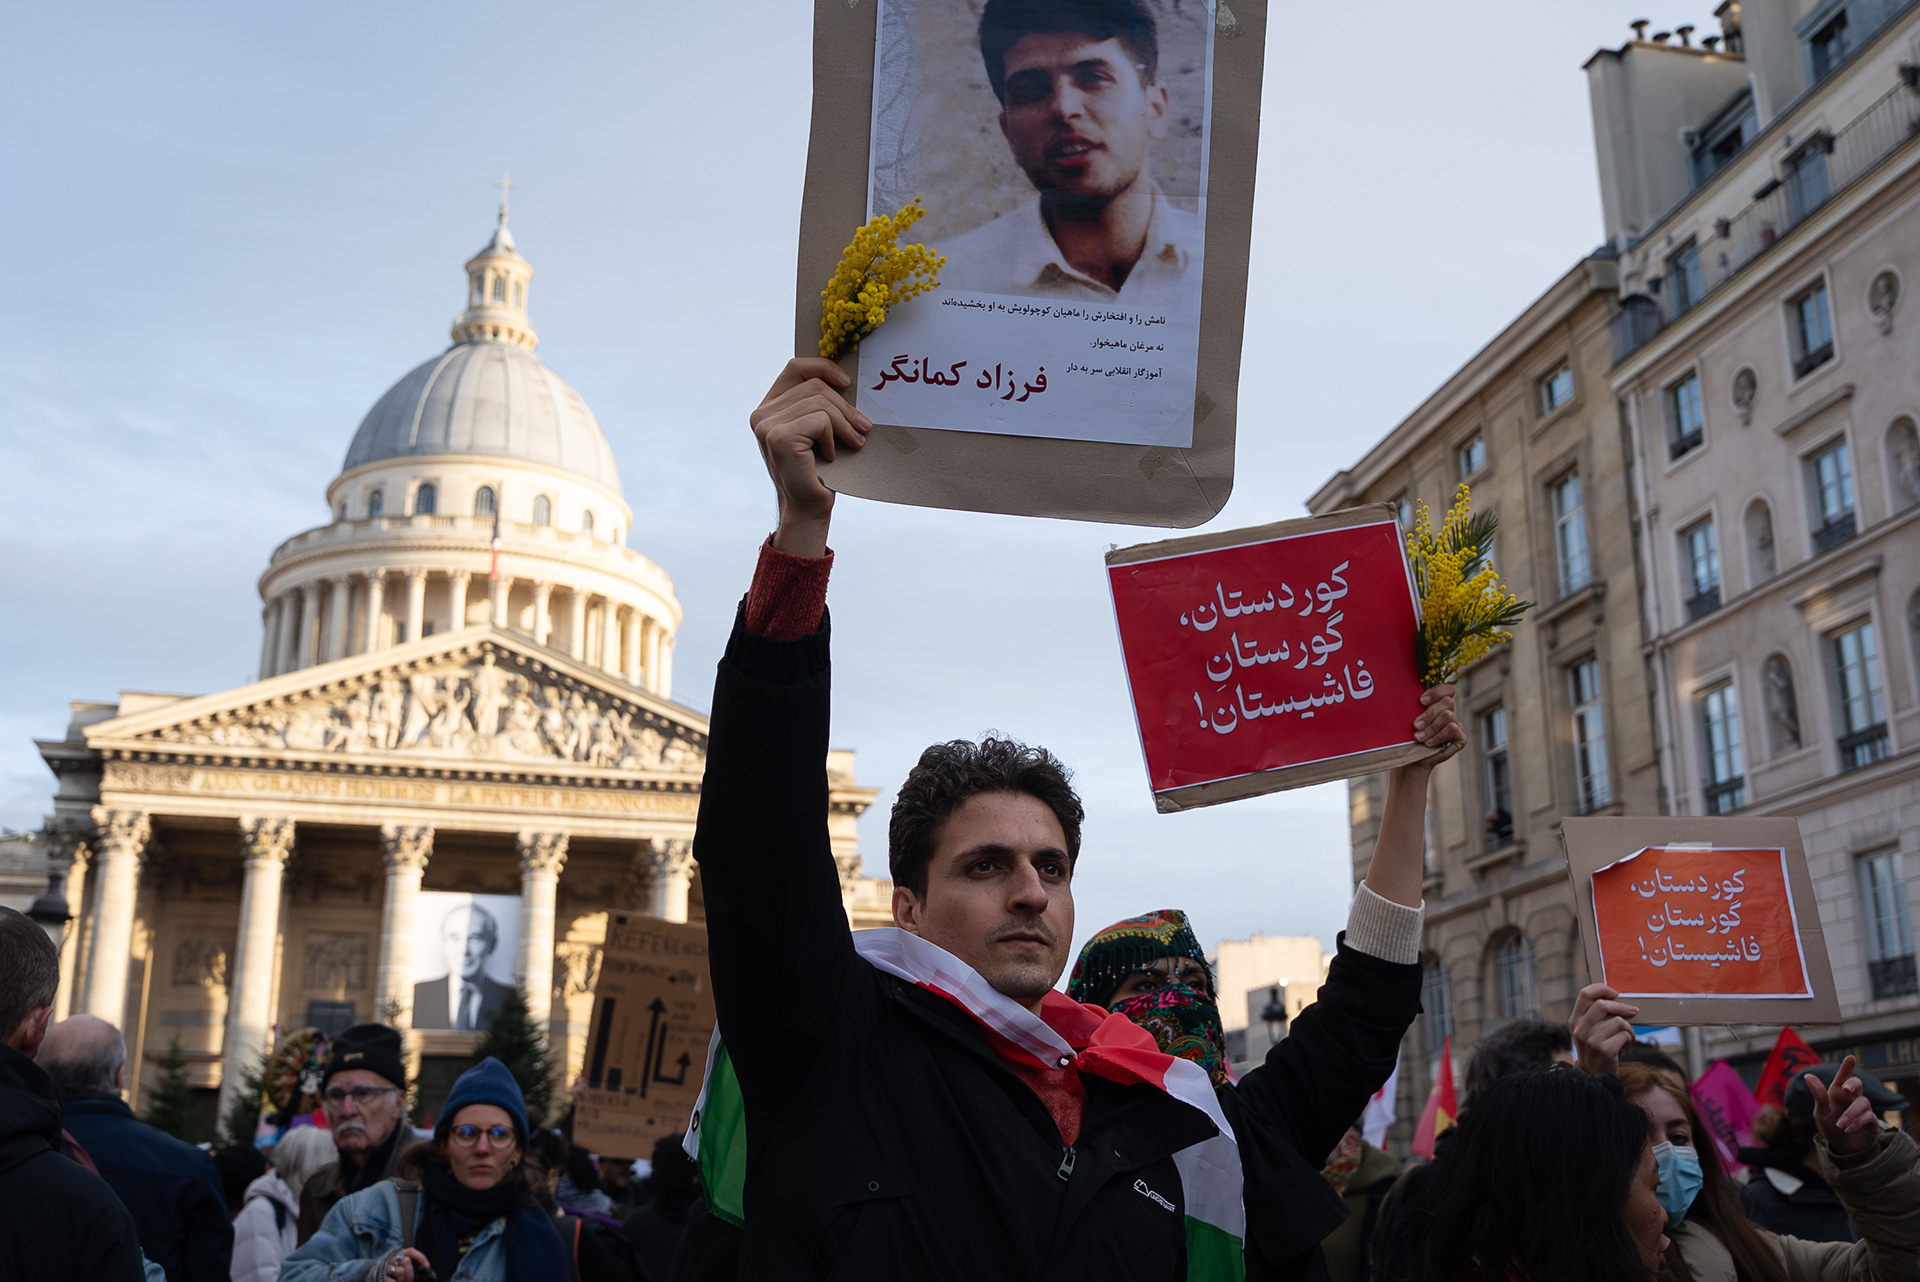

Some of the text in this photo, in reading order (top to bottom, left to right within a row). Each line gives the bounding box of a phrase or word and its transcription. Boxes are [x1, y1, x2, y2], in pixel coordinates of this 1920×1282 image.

[988, 301, 995, 312] او
[998, 303, 1005, 313] به
[1008, 303, 1051, 316] کوچولویش
[1053, 307, 1080, 318] ماهیان
[1082, 309, 1089, 320] را
[1091, 310, 1127, 322] افتخارش
[1129, 316, 1133, 325] و
[1136, 313, 1142, 325] را
[1145, 315, 1166, 326] نامش
[1090, 338, 1164, 353] نه مرغان ماهیخوار.
[1066, 362, 1162, 380] آموزگار انقلابی سر به دار
[871, 354, 1048, 403] فرزاد کمانگر
[1180, 559, 1350, 632] کوردستان،
[1193, 659, 1375, 735] فاشیستان!
[201, 772, 245, 790] AUX
[253, 775, 341, 795] GRANDS
[347, 780, 436, 801] HOMMES
[451, 785, 475, 803] LA
[482, 787, 553, 808] PATRIE
[1630, 867, 1746, 900] کوردستان،
[1637, 935, 1762, 967] فاشیستان!
